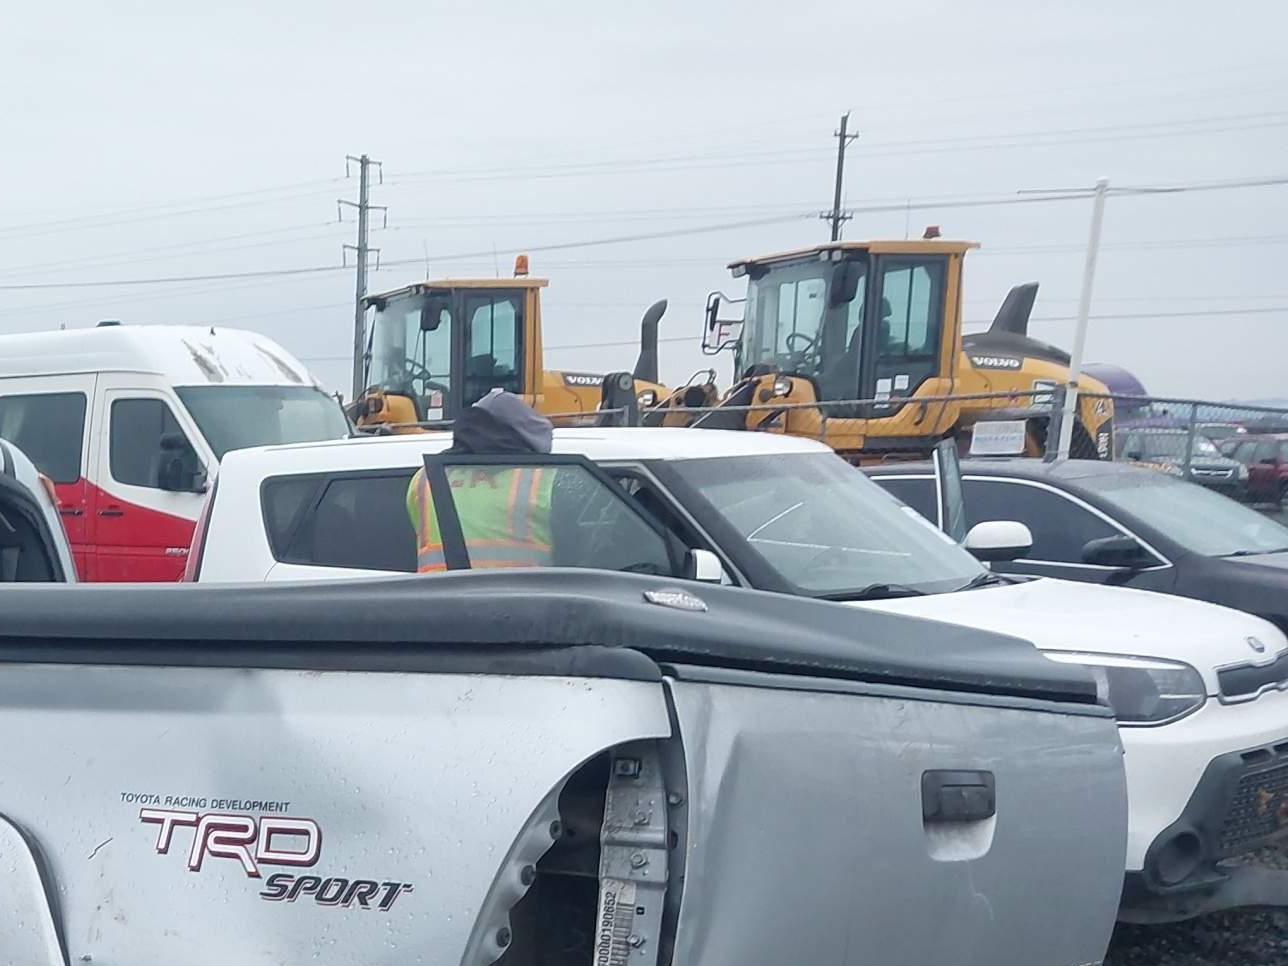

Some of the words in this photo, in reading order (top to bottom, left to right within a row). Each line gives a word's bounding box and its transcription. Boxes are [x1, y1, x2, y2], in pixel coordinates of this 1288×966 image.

[972, 356, 1020, 368] VOLVO
[566, 375, 604, 385] VOLV
[120, 792, 161, 805] TOYOTA
[164, 795, 207, 809] RACING
[210, 798, 290, 813] DEVELOPMENT
[139, 807, 322, 878] TRD
[259, 873, 413, 912] SPORT
